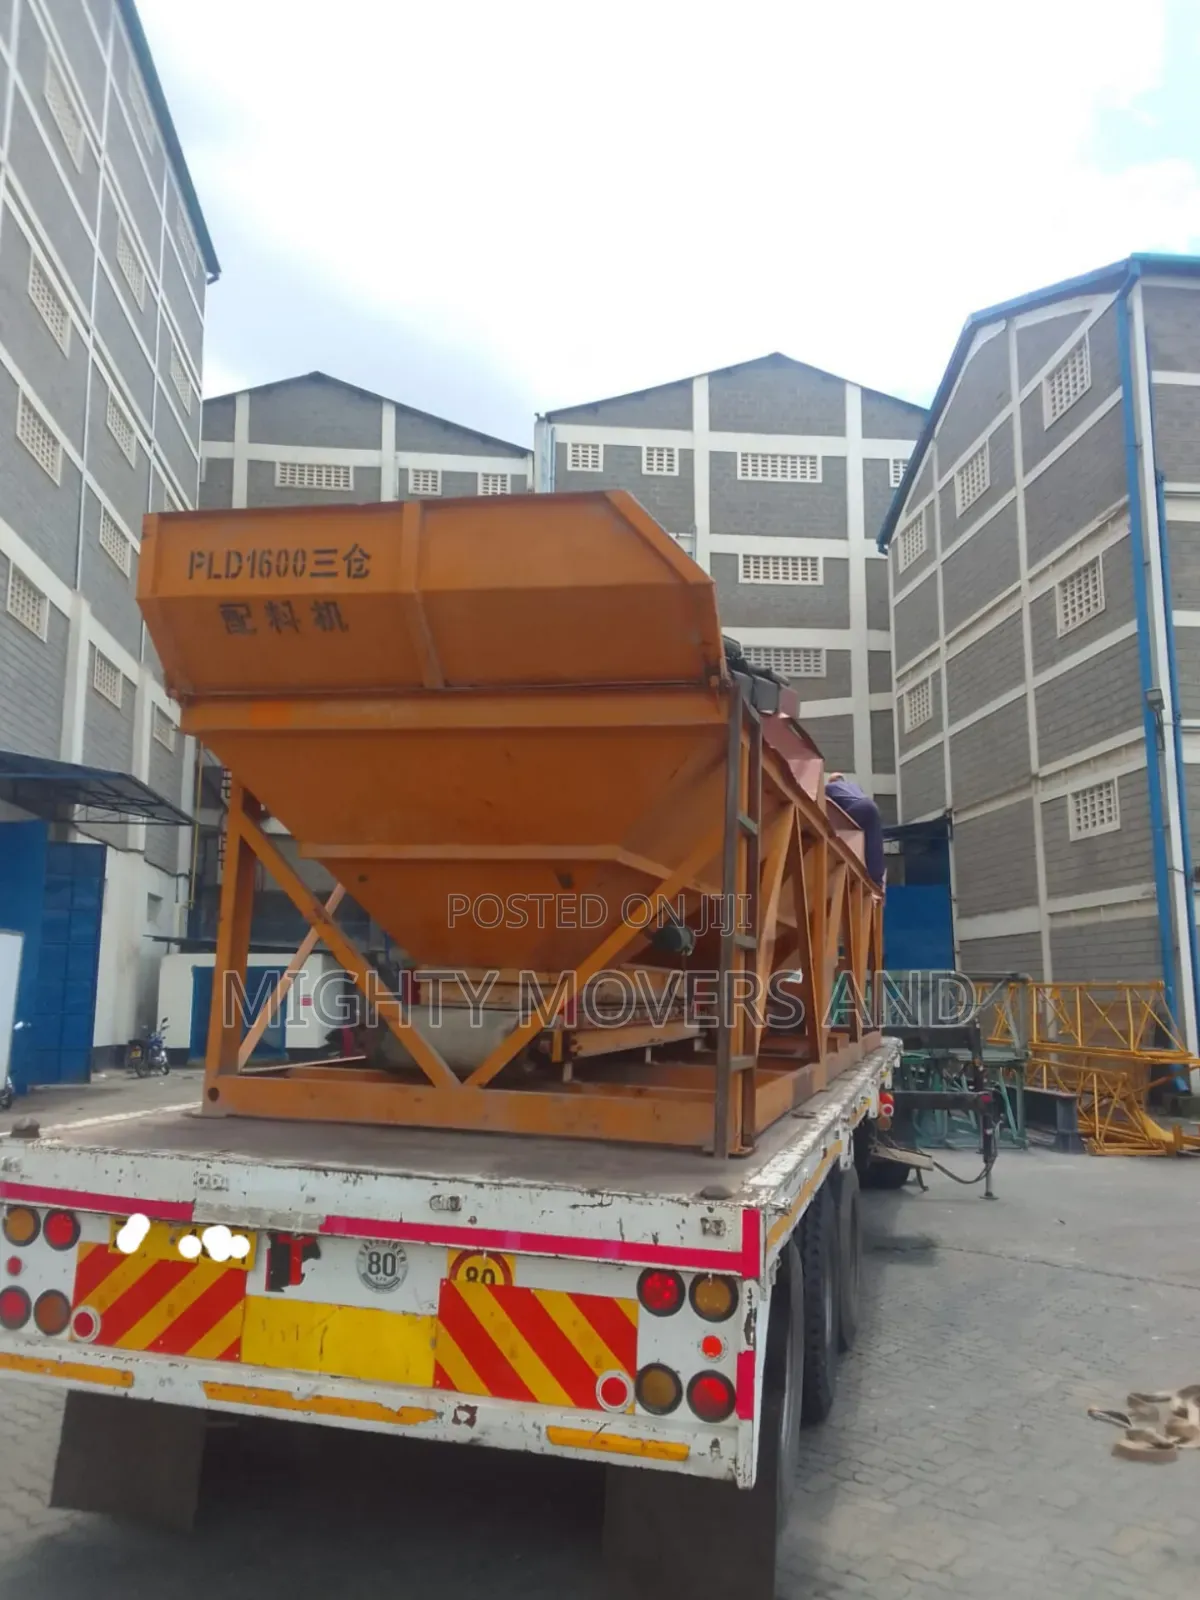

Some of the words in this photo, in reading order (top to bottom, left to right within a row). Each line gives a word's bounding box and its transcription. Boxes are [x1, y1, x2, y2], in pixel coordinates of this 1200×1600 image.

[219, 600, 349, 635] 配料机
[368, 1251, 396, 1277] 80
